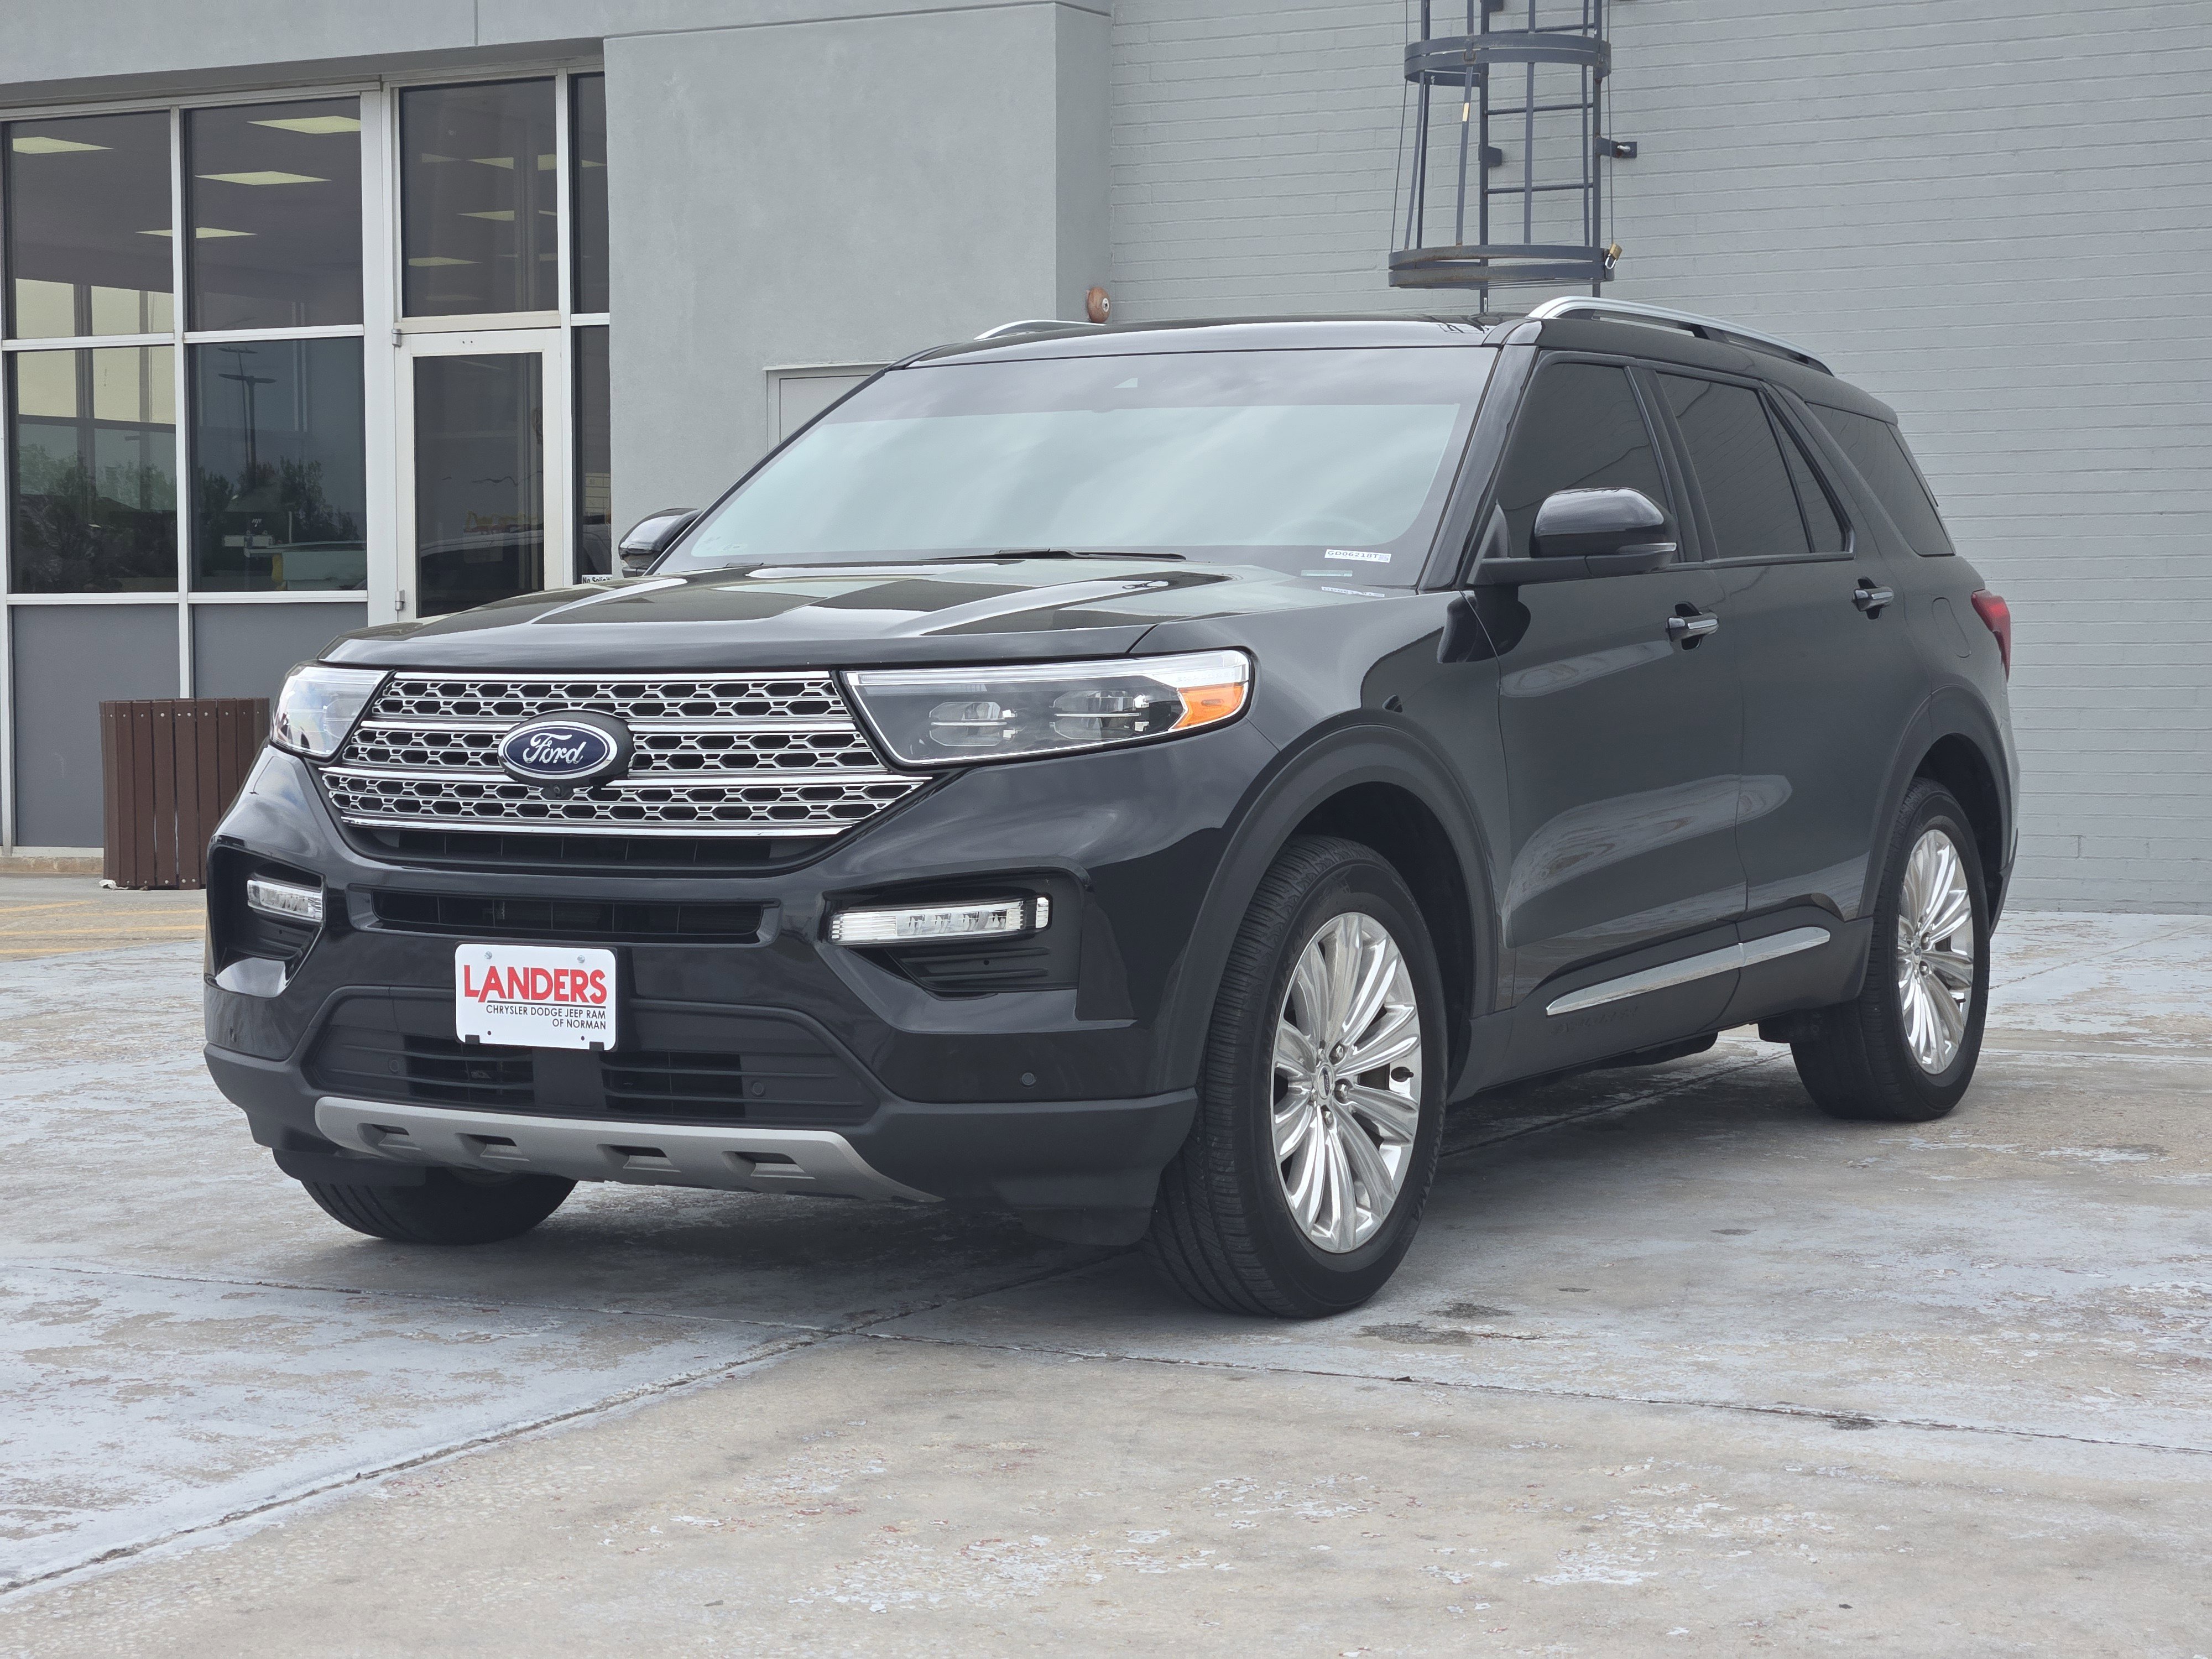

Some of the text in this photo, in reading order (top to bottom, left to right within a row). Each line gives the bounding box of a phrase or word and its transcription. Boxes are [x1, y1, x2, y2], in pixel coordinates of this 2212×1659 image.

[1327, 550, 1379, 559] GD06218T
[523, 733, 587, 764] Ford
[463, 964, 607, 1005] LANDERS
[486, 1004, 606, 1019] CHRYSLER DODGE JEEP RAM
[552, 1018, 606, 1030] OF NORMAN
